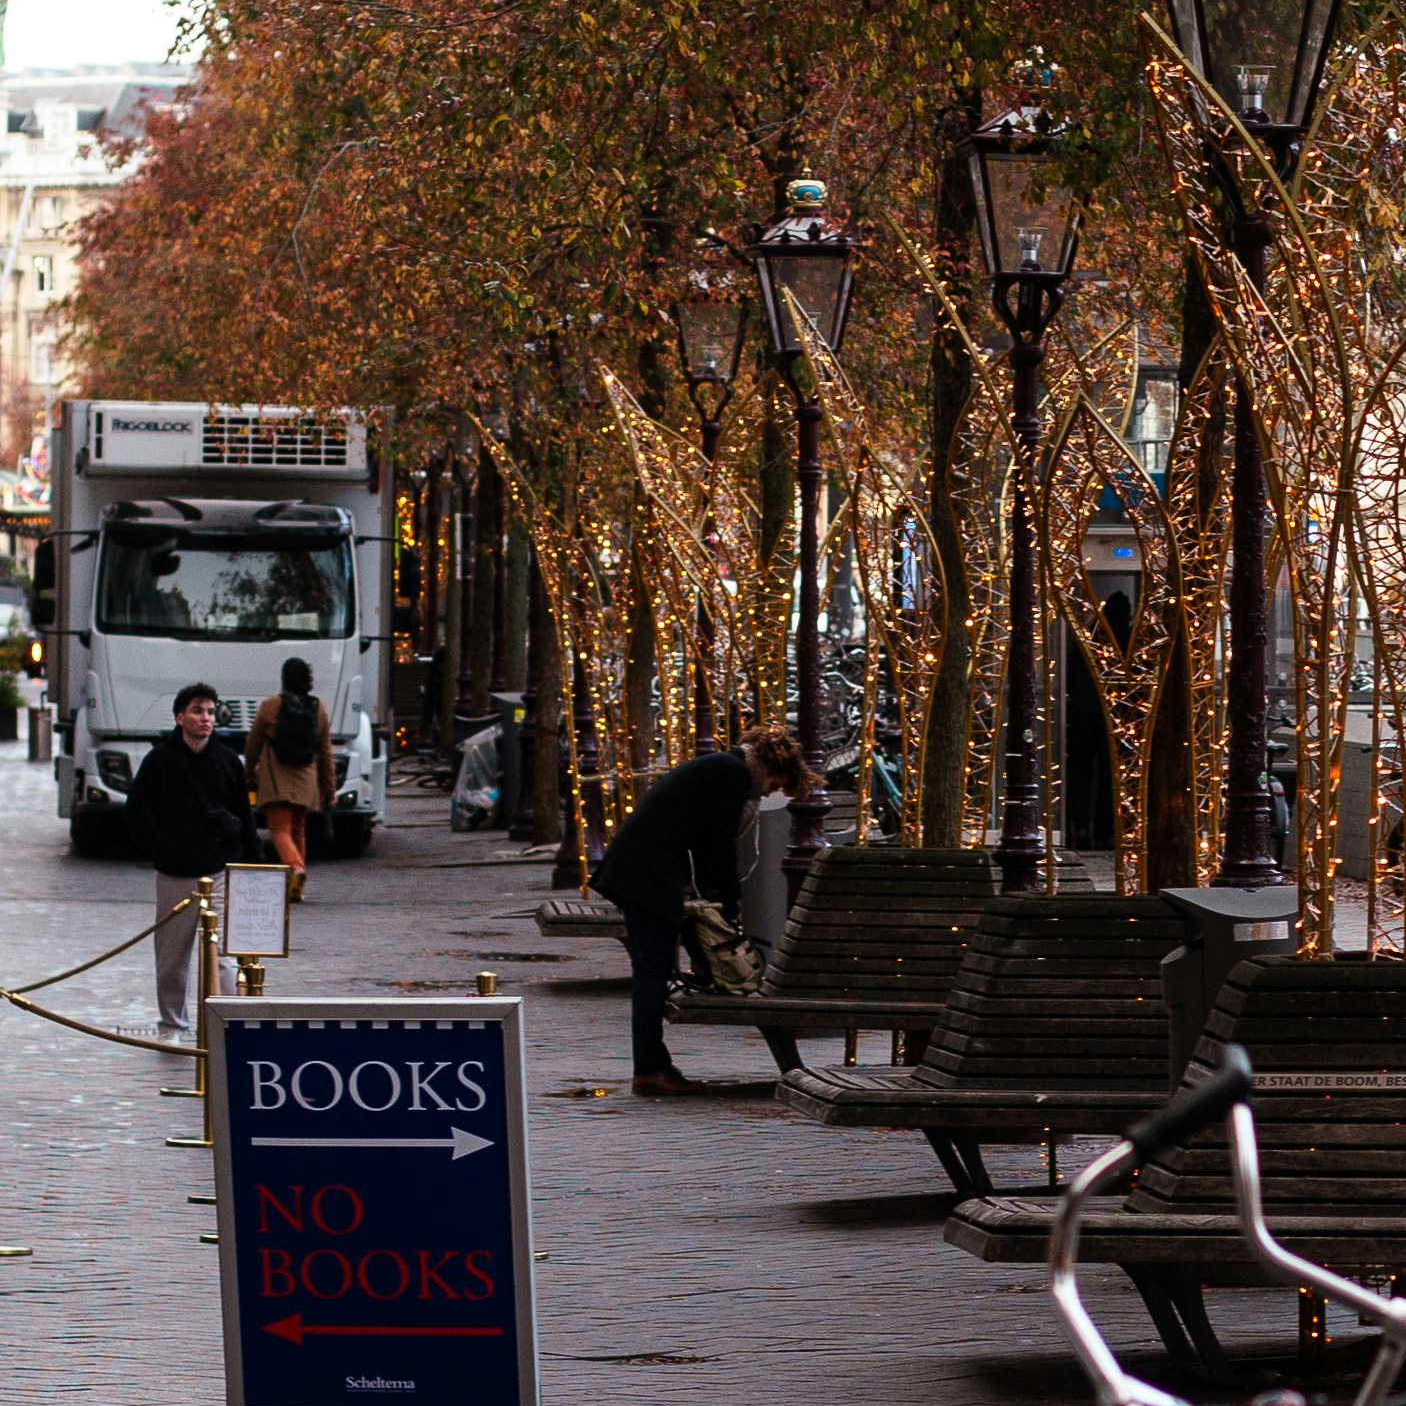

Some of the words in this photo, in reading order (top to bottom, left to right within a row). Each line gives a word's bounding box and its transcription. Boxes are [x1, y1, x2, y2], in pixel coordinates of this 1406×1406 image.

[111, 418, 193, 433] FRIGOBLOCK
[246, 1060, 487, 1112] BOOKS
[1269, 1076, 1311, 1087] STAAT
[1314, 1076, 1332, 1087] DE
[1335, 1076, 1382, 1088] BOOM,
[253, 1183, 365, 1236] NO
[256, 1247, 496, 1301] BOOKS
[345, 1375, 416, 1389] Scheltema
